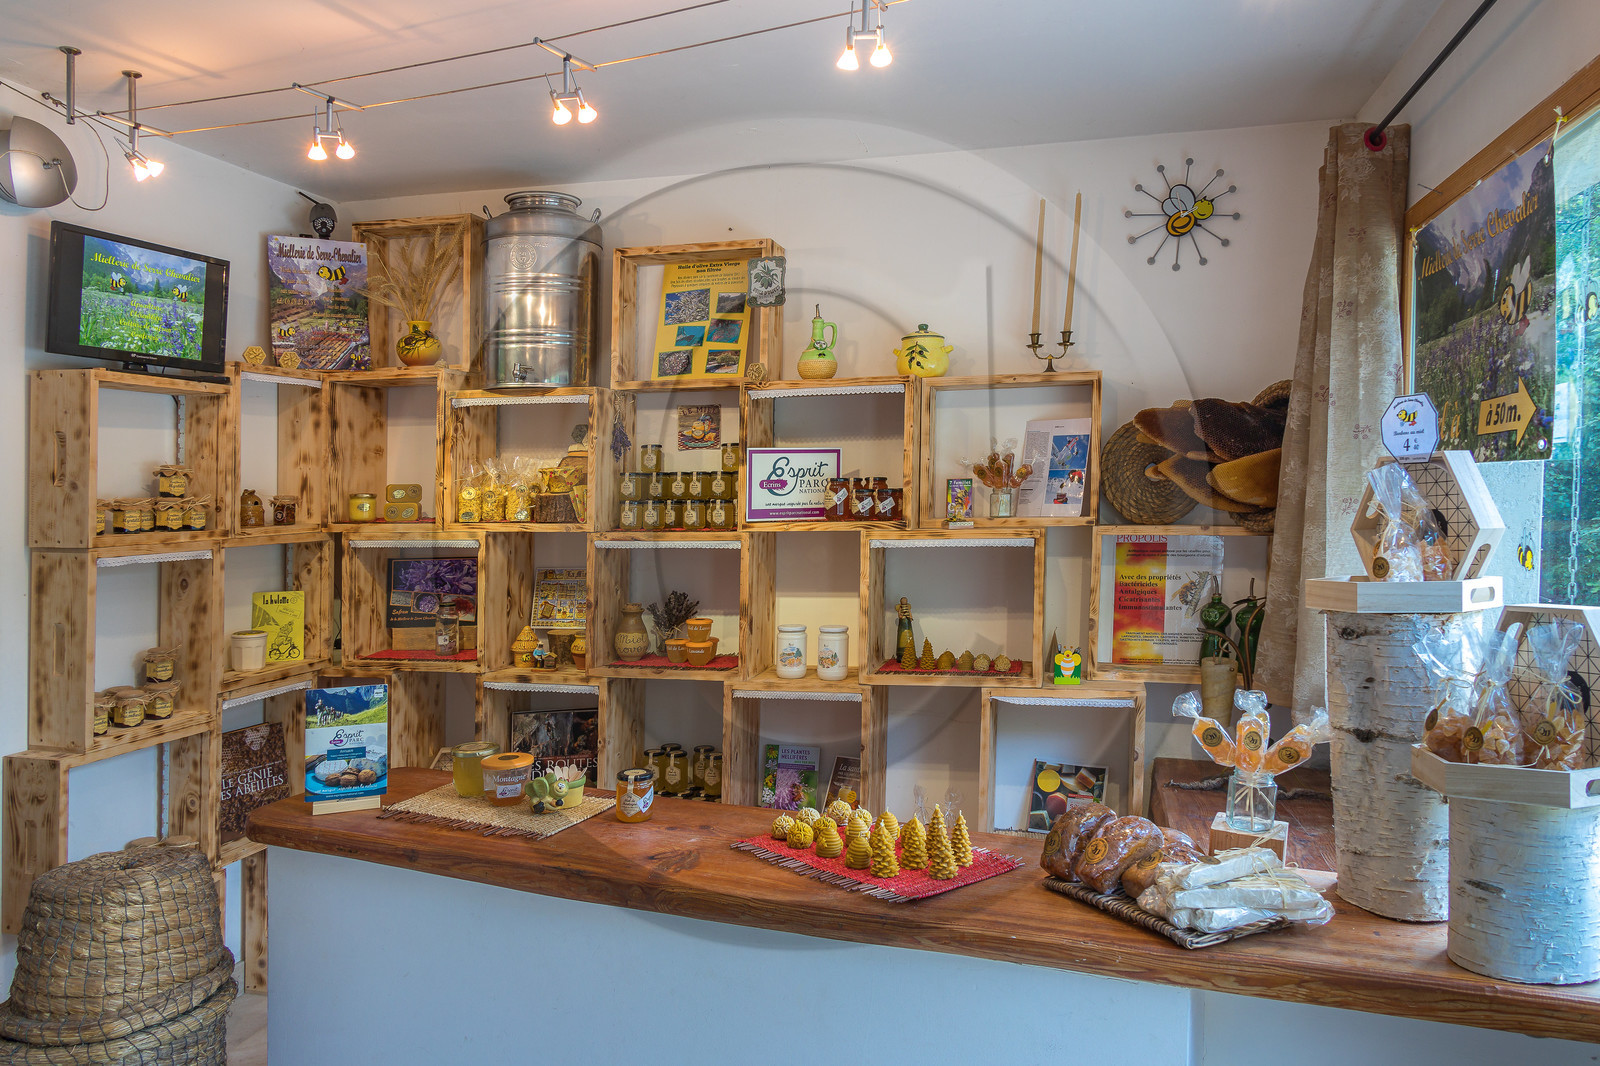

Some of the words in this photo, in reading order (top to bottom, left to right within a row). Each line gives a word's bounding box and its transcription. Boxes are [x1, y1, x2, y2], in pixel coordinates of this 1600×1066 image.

[1461, 227, 1486, 254] Serre
[1486, 190, 1539, 238] Chevalier
[276, 243, 306, 260] Miellerie
[306, 245, 315, 260] de
[90, 252, 130, 269] Miellerie
[131, 261, 141, 270] de
[143, 263, 164, 275] Serre
[165, 267, 201, 283] Chevalier
[1485, 404, 1492, 427] à
[1403, 438, 1411, 452] 4
[767, 456, 829, 496] Esprit
[1116, 535, 1168, 543] PROPOLIS
[332, 728, 364, 747] Esprit
[547, 757, 598, 769] ROUTES
[222, 778, 235, 790] LE
[237, 767, 273, 785] GÉNIE
[235, 773, 284, 797] ABEILLES
[493, 774, 526, 783] Montagne
